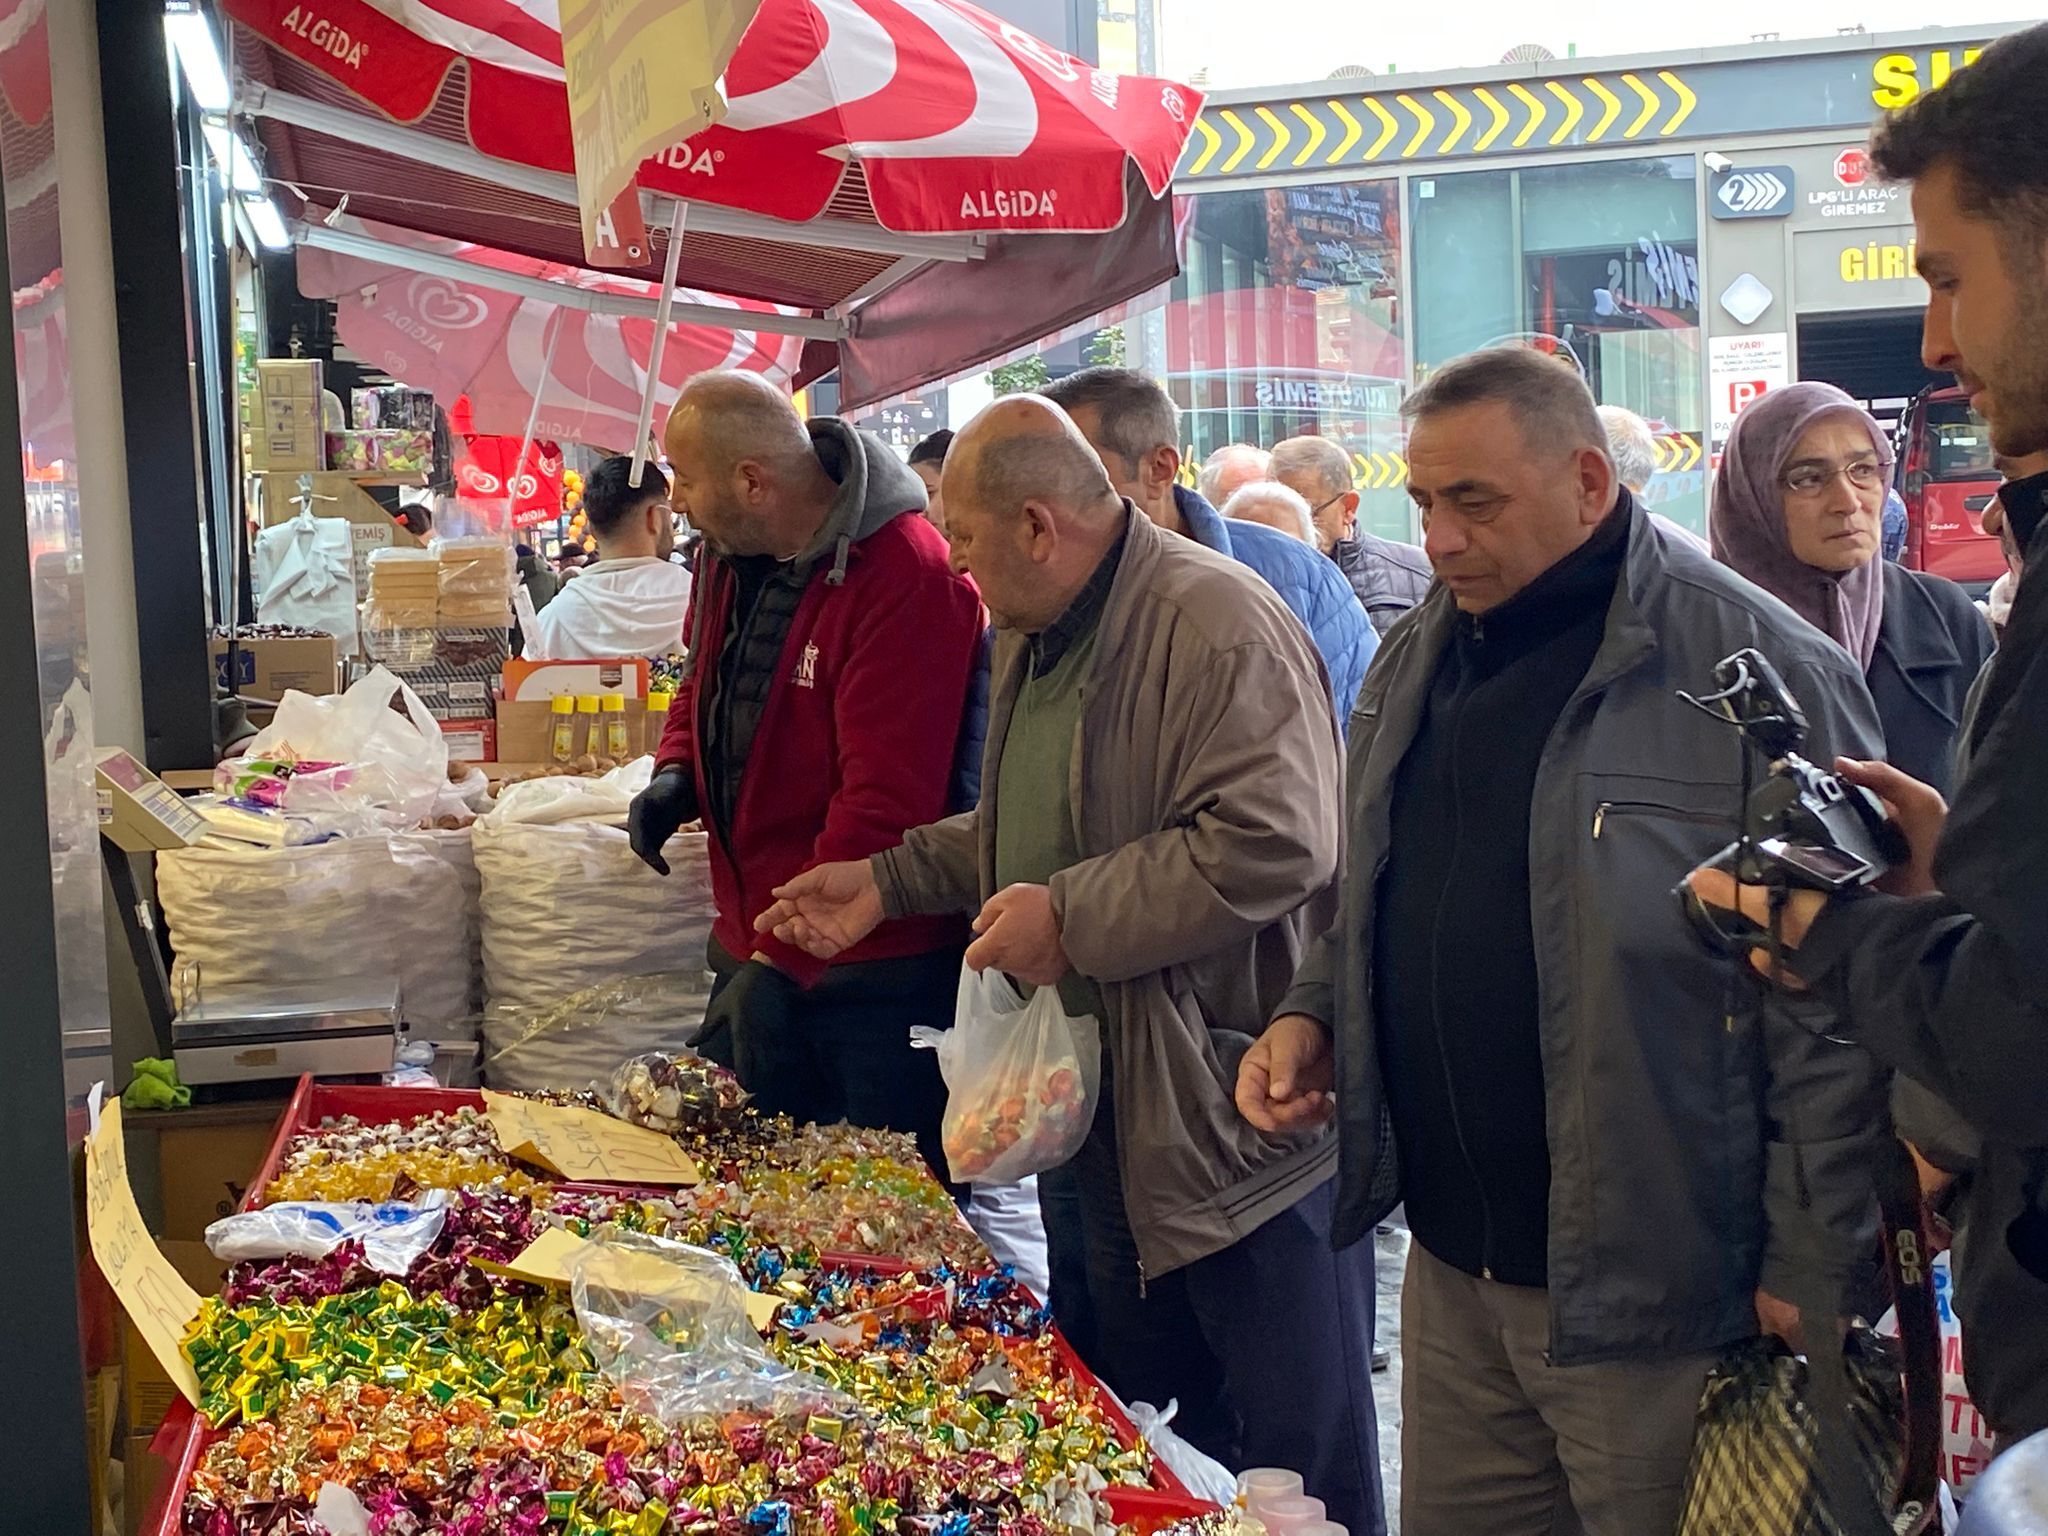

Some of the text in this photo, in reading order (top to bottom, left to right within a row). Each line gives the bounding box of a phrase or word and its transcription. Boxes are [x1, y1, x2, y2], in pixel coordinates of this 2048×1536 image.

[1728, 179, 1745, 206] 2
[1857, 186, 1899, 201] ARAÇ
[1896, 1228, 1923, 1285] EOS
